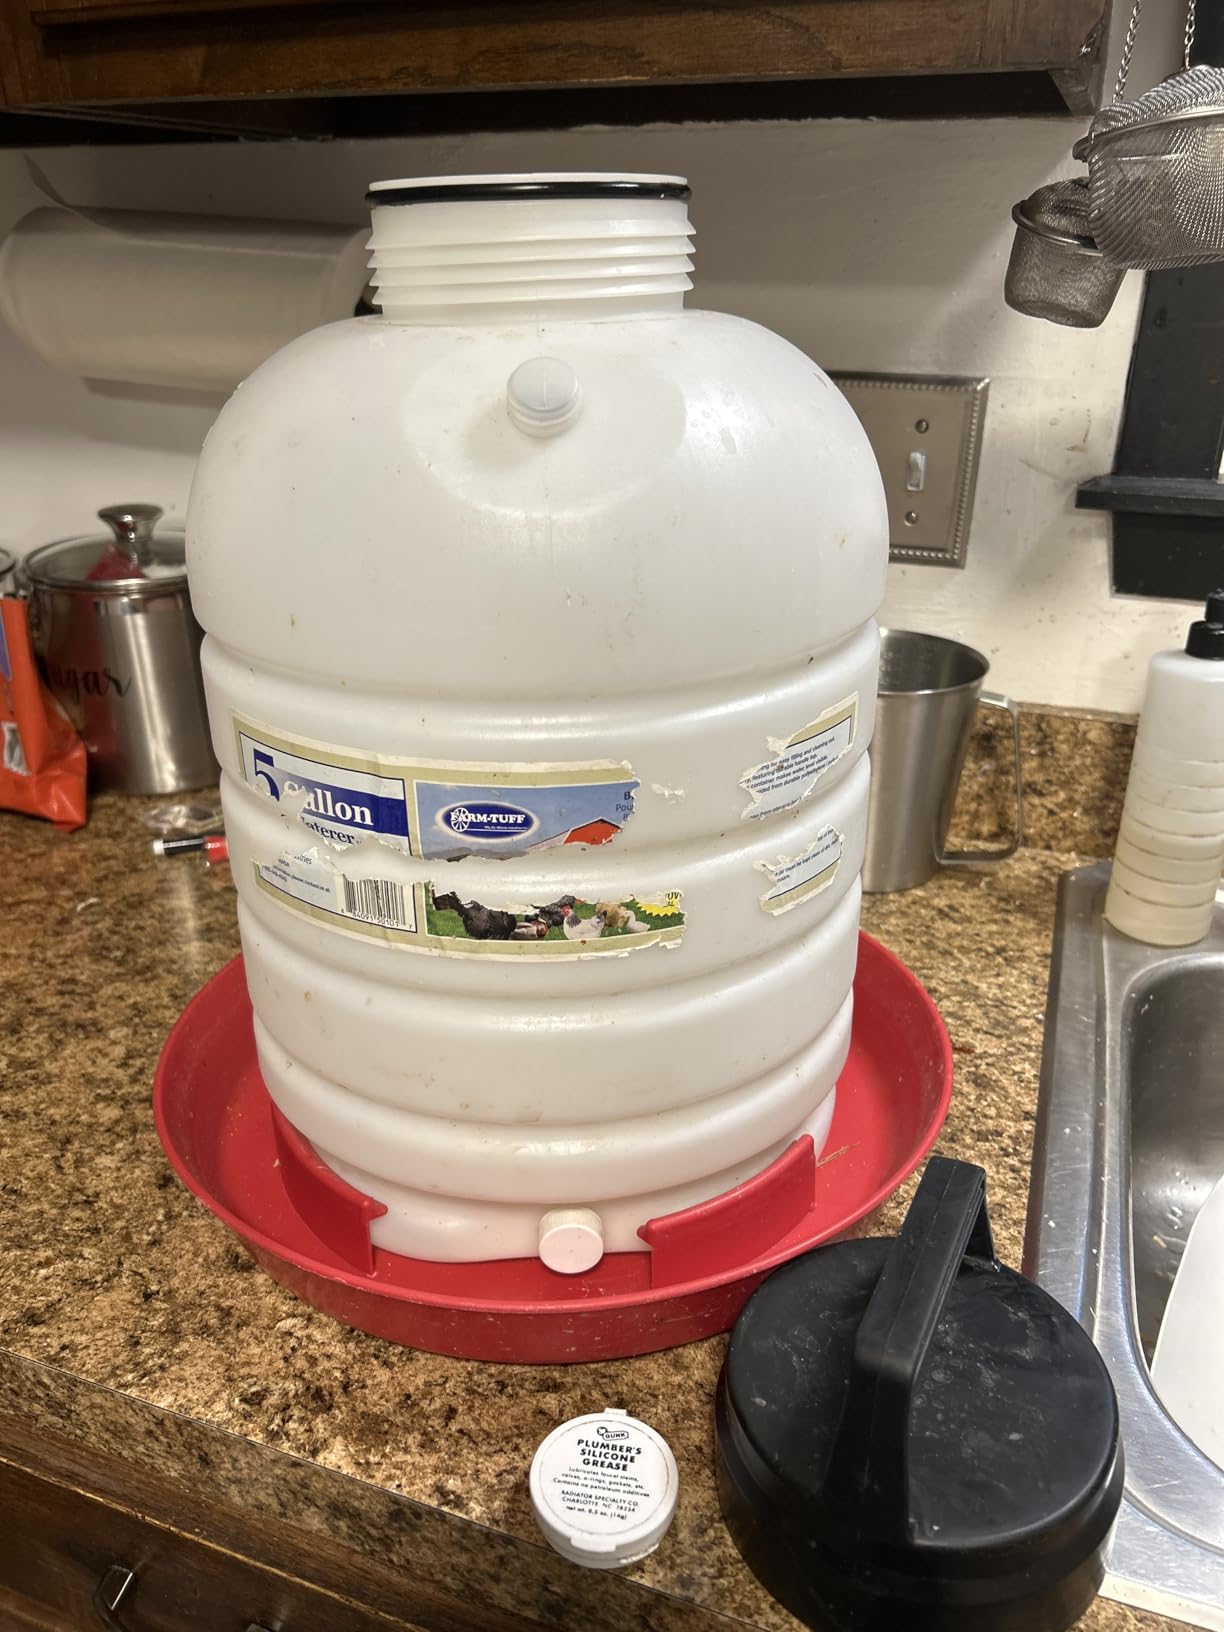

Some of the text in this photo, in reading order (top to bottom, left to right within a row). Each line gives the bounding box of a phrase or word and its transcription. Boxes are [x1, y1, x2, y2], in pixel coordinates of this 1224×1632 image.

[450, 811, 525, 824] FARM-TUFF
[301, 816, 356, 845] aterer
[604, 1432, 626, 1440] GUNK
[577, 1438, 642, 1455] PLUMBER'S
[580, 1448, 636, 1463] SILICONE
[582, 1458, 628, 1472] GREASE
[561, 1489, 593, 1500] RADIATOR
[594, 1494, 626, 1505] SPECIALTY
[561, 1496, 599, 1508] CHARLOTTE
